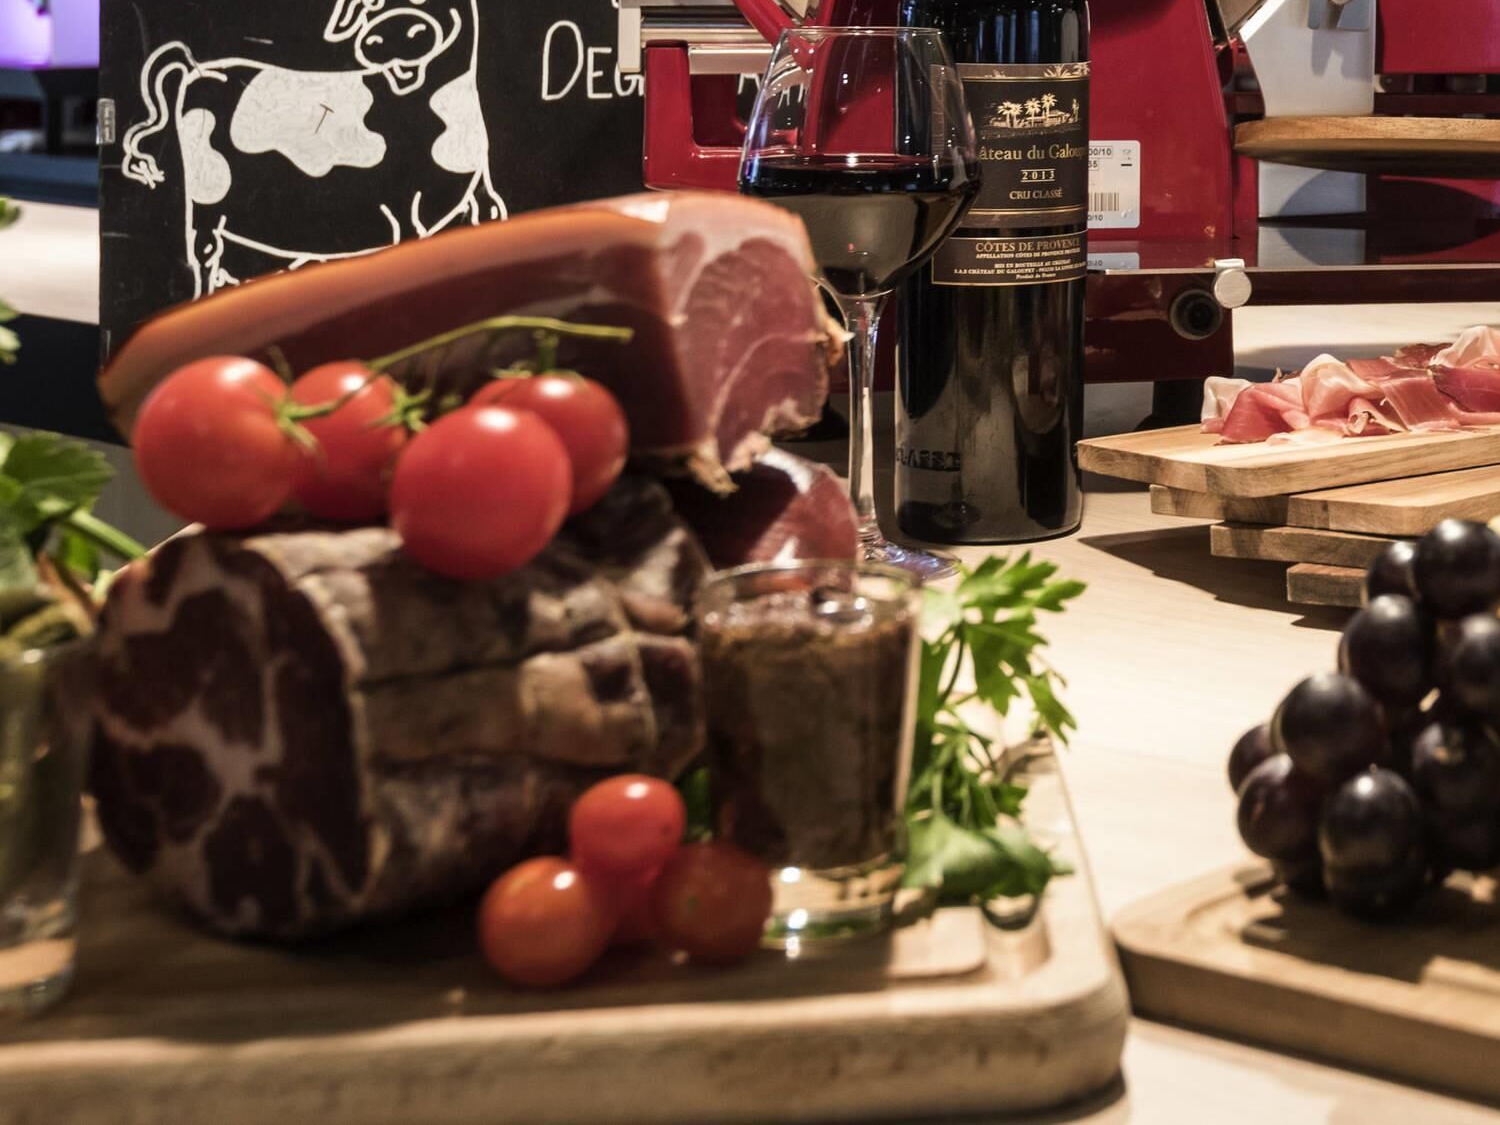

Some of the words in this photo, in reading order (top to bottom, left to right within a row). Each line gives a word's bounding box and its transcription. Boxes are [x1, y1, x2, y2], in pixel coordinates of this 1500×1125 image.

[977, 146, 1022, 161] âteau
[1027, 145, 1045, 161] du
[1009, 191, 1030, 200] CRU
[975, 241, 1015, 253] CÔTES
[1019, 242, 1034, 252] DE
